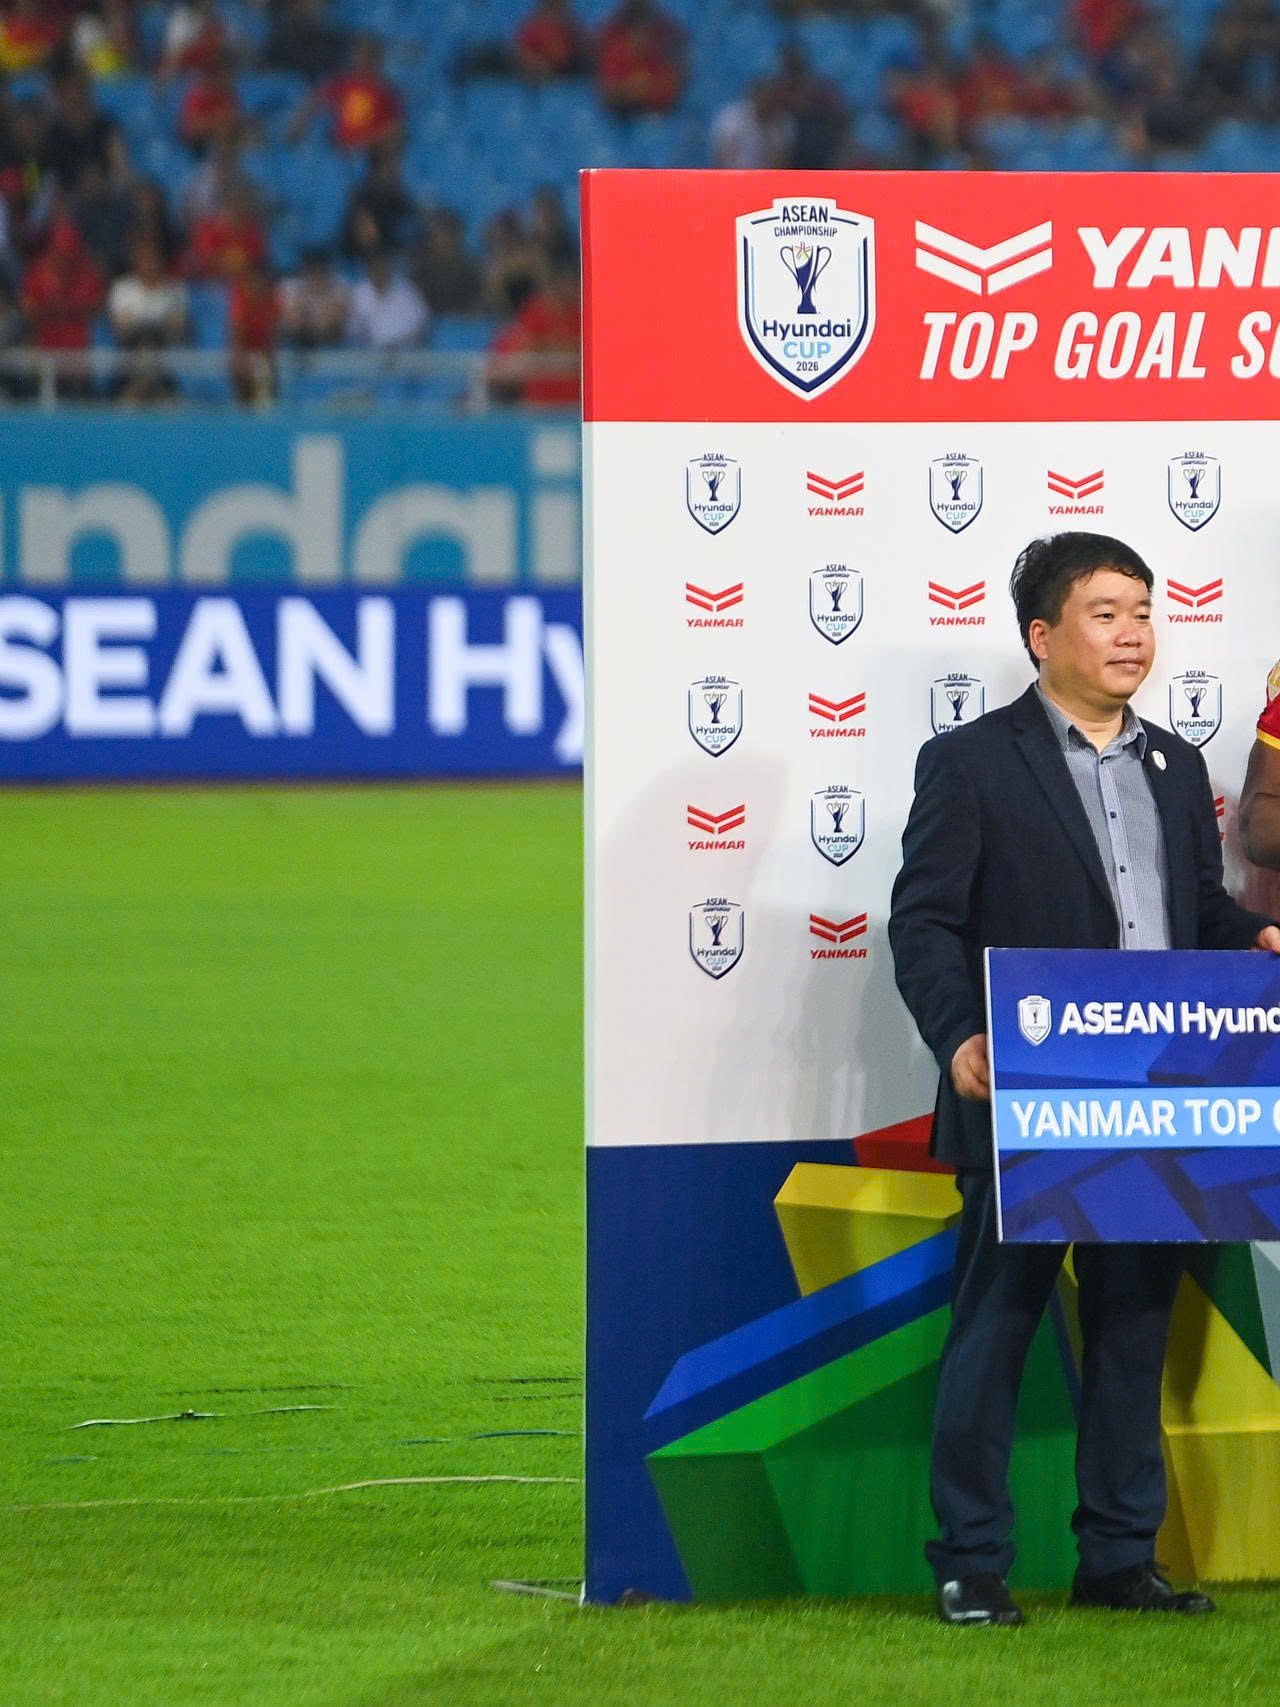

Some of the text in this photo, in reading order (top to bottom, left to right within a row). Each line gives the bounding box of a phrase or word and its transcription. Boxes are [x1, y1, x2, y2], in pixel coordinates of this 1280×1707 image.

[782, 205, 828, 223] ASEAN
[774, 225, 838, 237] CHAMPIONSHIP
[763, 319, 851, 341] Hyundai
[783, 341, 831, 359] CUP
[919, 311, 1039, 380] TOP
[1053, 311, 1207, 379] GOAL
[796, 361, 819, 372] 2026
[946, 453, 966, 461] ASEAN
[0, 433, 579, 583] ndai
[695, 503, 733, 513] Hyundai
[937, 502, 975, 512] Hyundai
[1176, 500, 1213, 510] Hyundai
[808, 508, 864, 516] YANMAR
[1049, 506, 1103, 514] YANMAR
[1184, 510, 1204, 518] CUP
[826, 564, 846, 572] ASEAN
[817, 613, 856, 623] Hyundai
[930, 617, 985, 625] YANMAR
[1168, 614, 1223, 622] YANMAR
[687, 619, 743, 627] YANMAR
[827, 623, 847, 631] CUP
[705, 676, 725, 684] ASEAN
[947, 673, 968, 681] ASEAN
[1177, 719, 1214, 729] Hyundai
[696, 725, 735, 735] Hyundai
[810, 728, 865, 737] YANMAR
[705, 735, 726, 743] CUP
[819, 834, 857, 844] Hyundai
[688, 841, 745, 849] YANMAR
[828, 844, 848, 852] CUP
[697, 948, 736, 958] Hyundai
[811, 949, 867, 958] YANMAR
[706, 957, 727, 965] CUP
[1059, 1001, 1175, 1035] ASEAN
[1011, 1100, 1177, 1137] YANMAR
[1184, 1098, 1261, 1136] TOP
